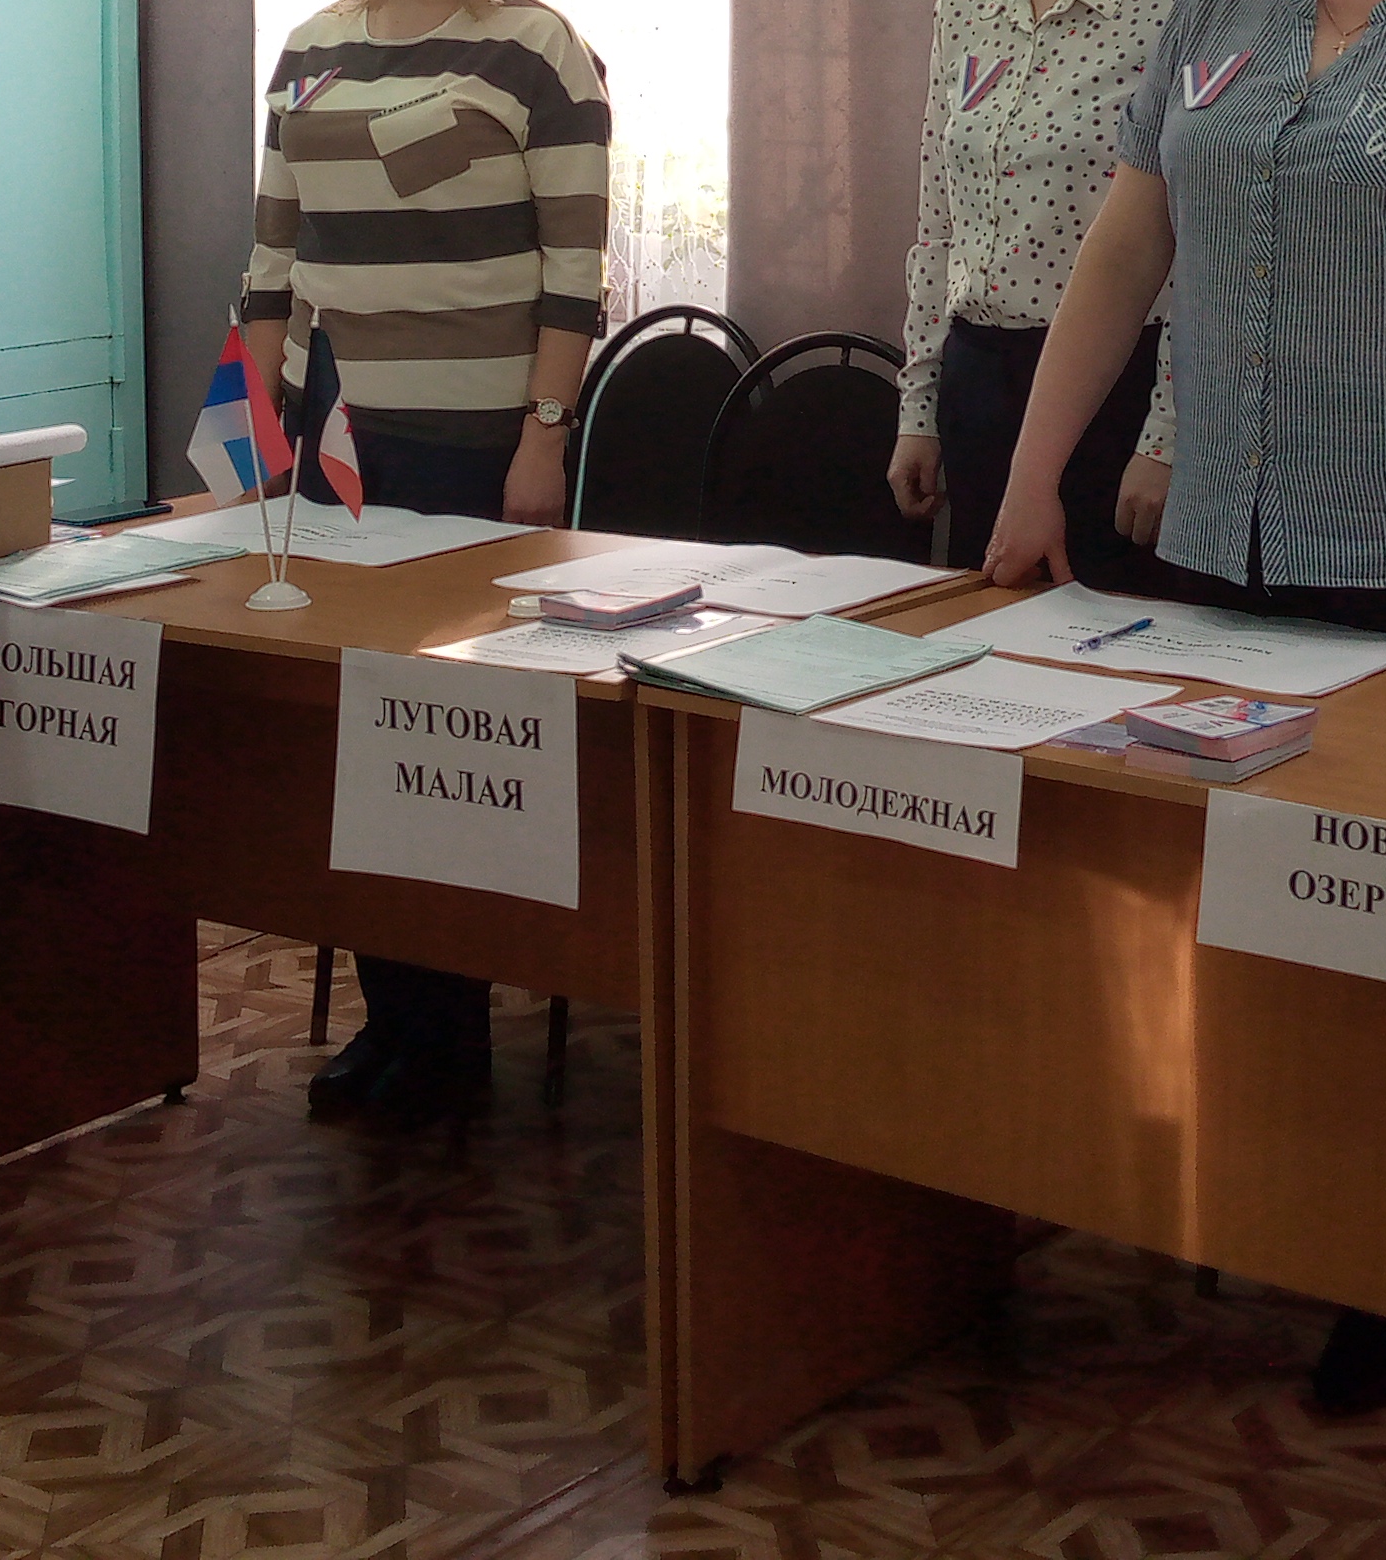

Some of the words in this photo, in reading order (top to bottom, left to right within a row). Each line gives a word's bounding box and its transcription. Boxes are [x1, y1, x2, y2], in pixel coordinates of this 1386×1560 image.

[374, 696, 543, 751] ЛУГОВАЯ
[394, 761, 525, 812] МАЛАЯ
[759, 765, 997, 840] МОЛОДЕЖНАЯ
